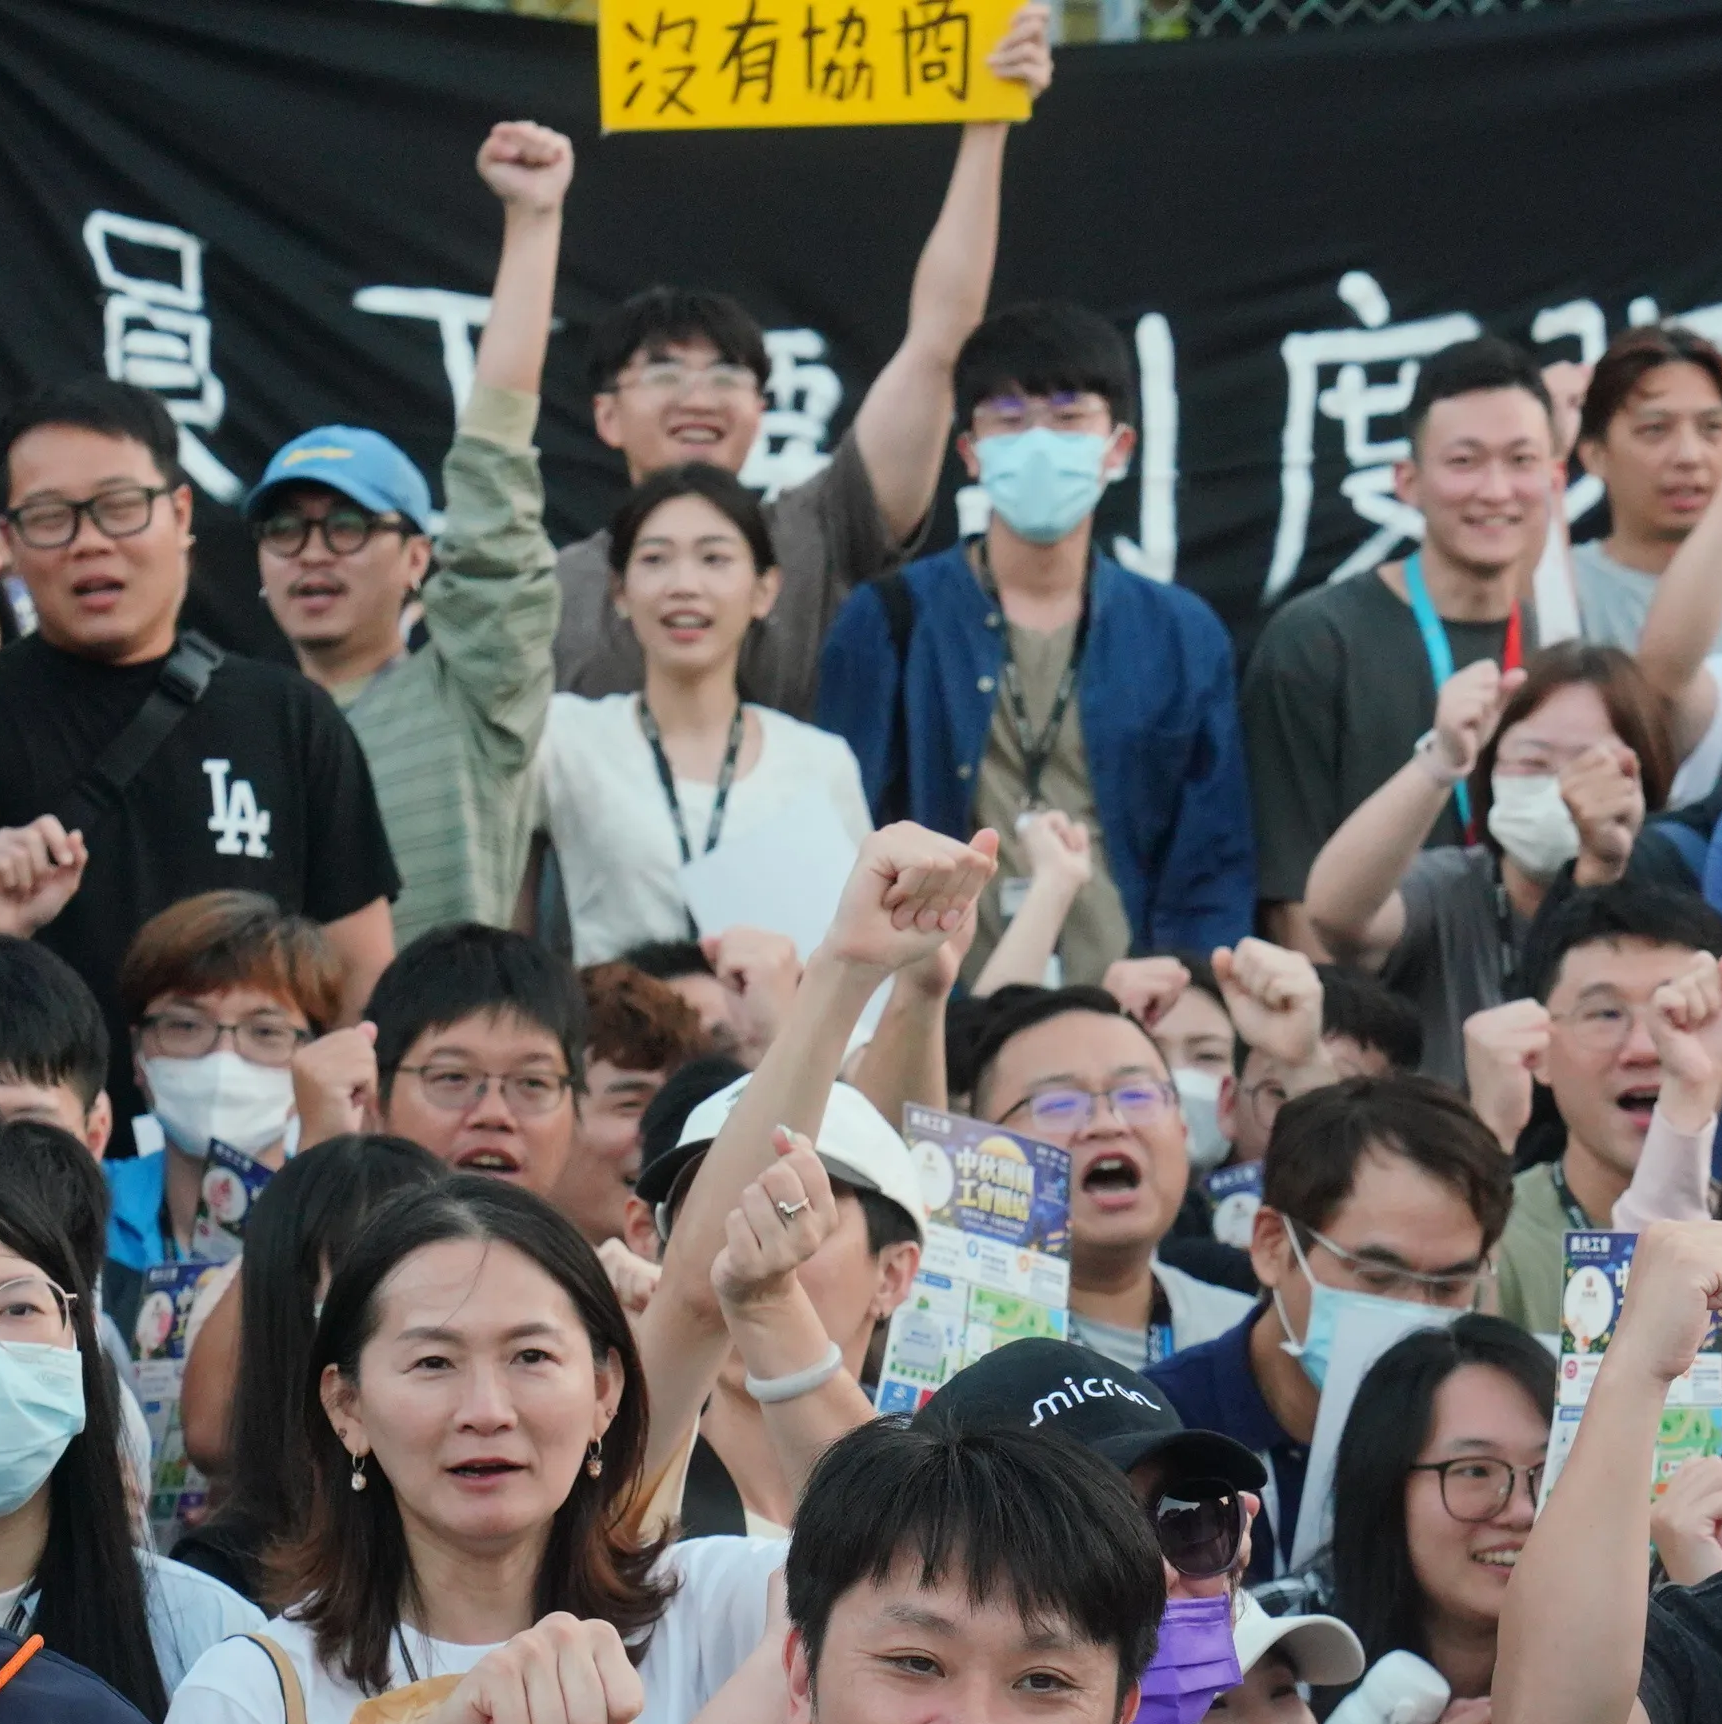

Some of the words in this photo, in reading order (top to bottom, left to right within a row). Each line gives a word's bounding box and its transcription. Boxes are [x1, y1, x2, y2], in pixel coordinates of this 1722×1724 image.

[622, 0, 971, 115] 沒有協商
[202, 758, 272, 858] LA
[1028, 1376, 1162, 1427] micron
